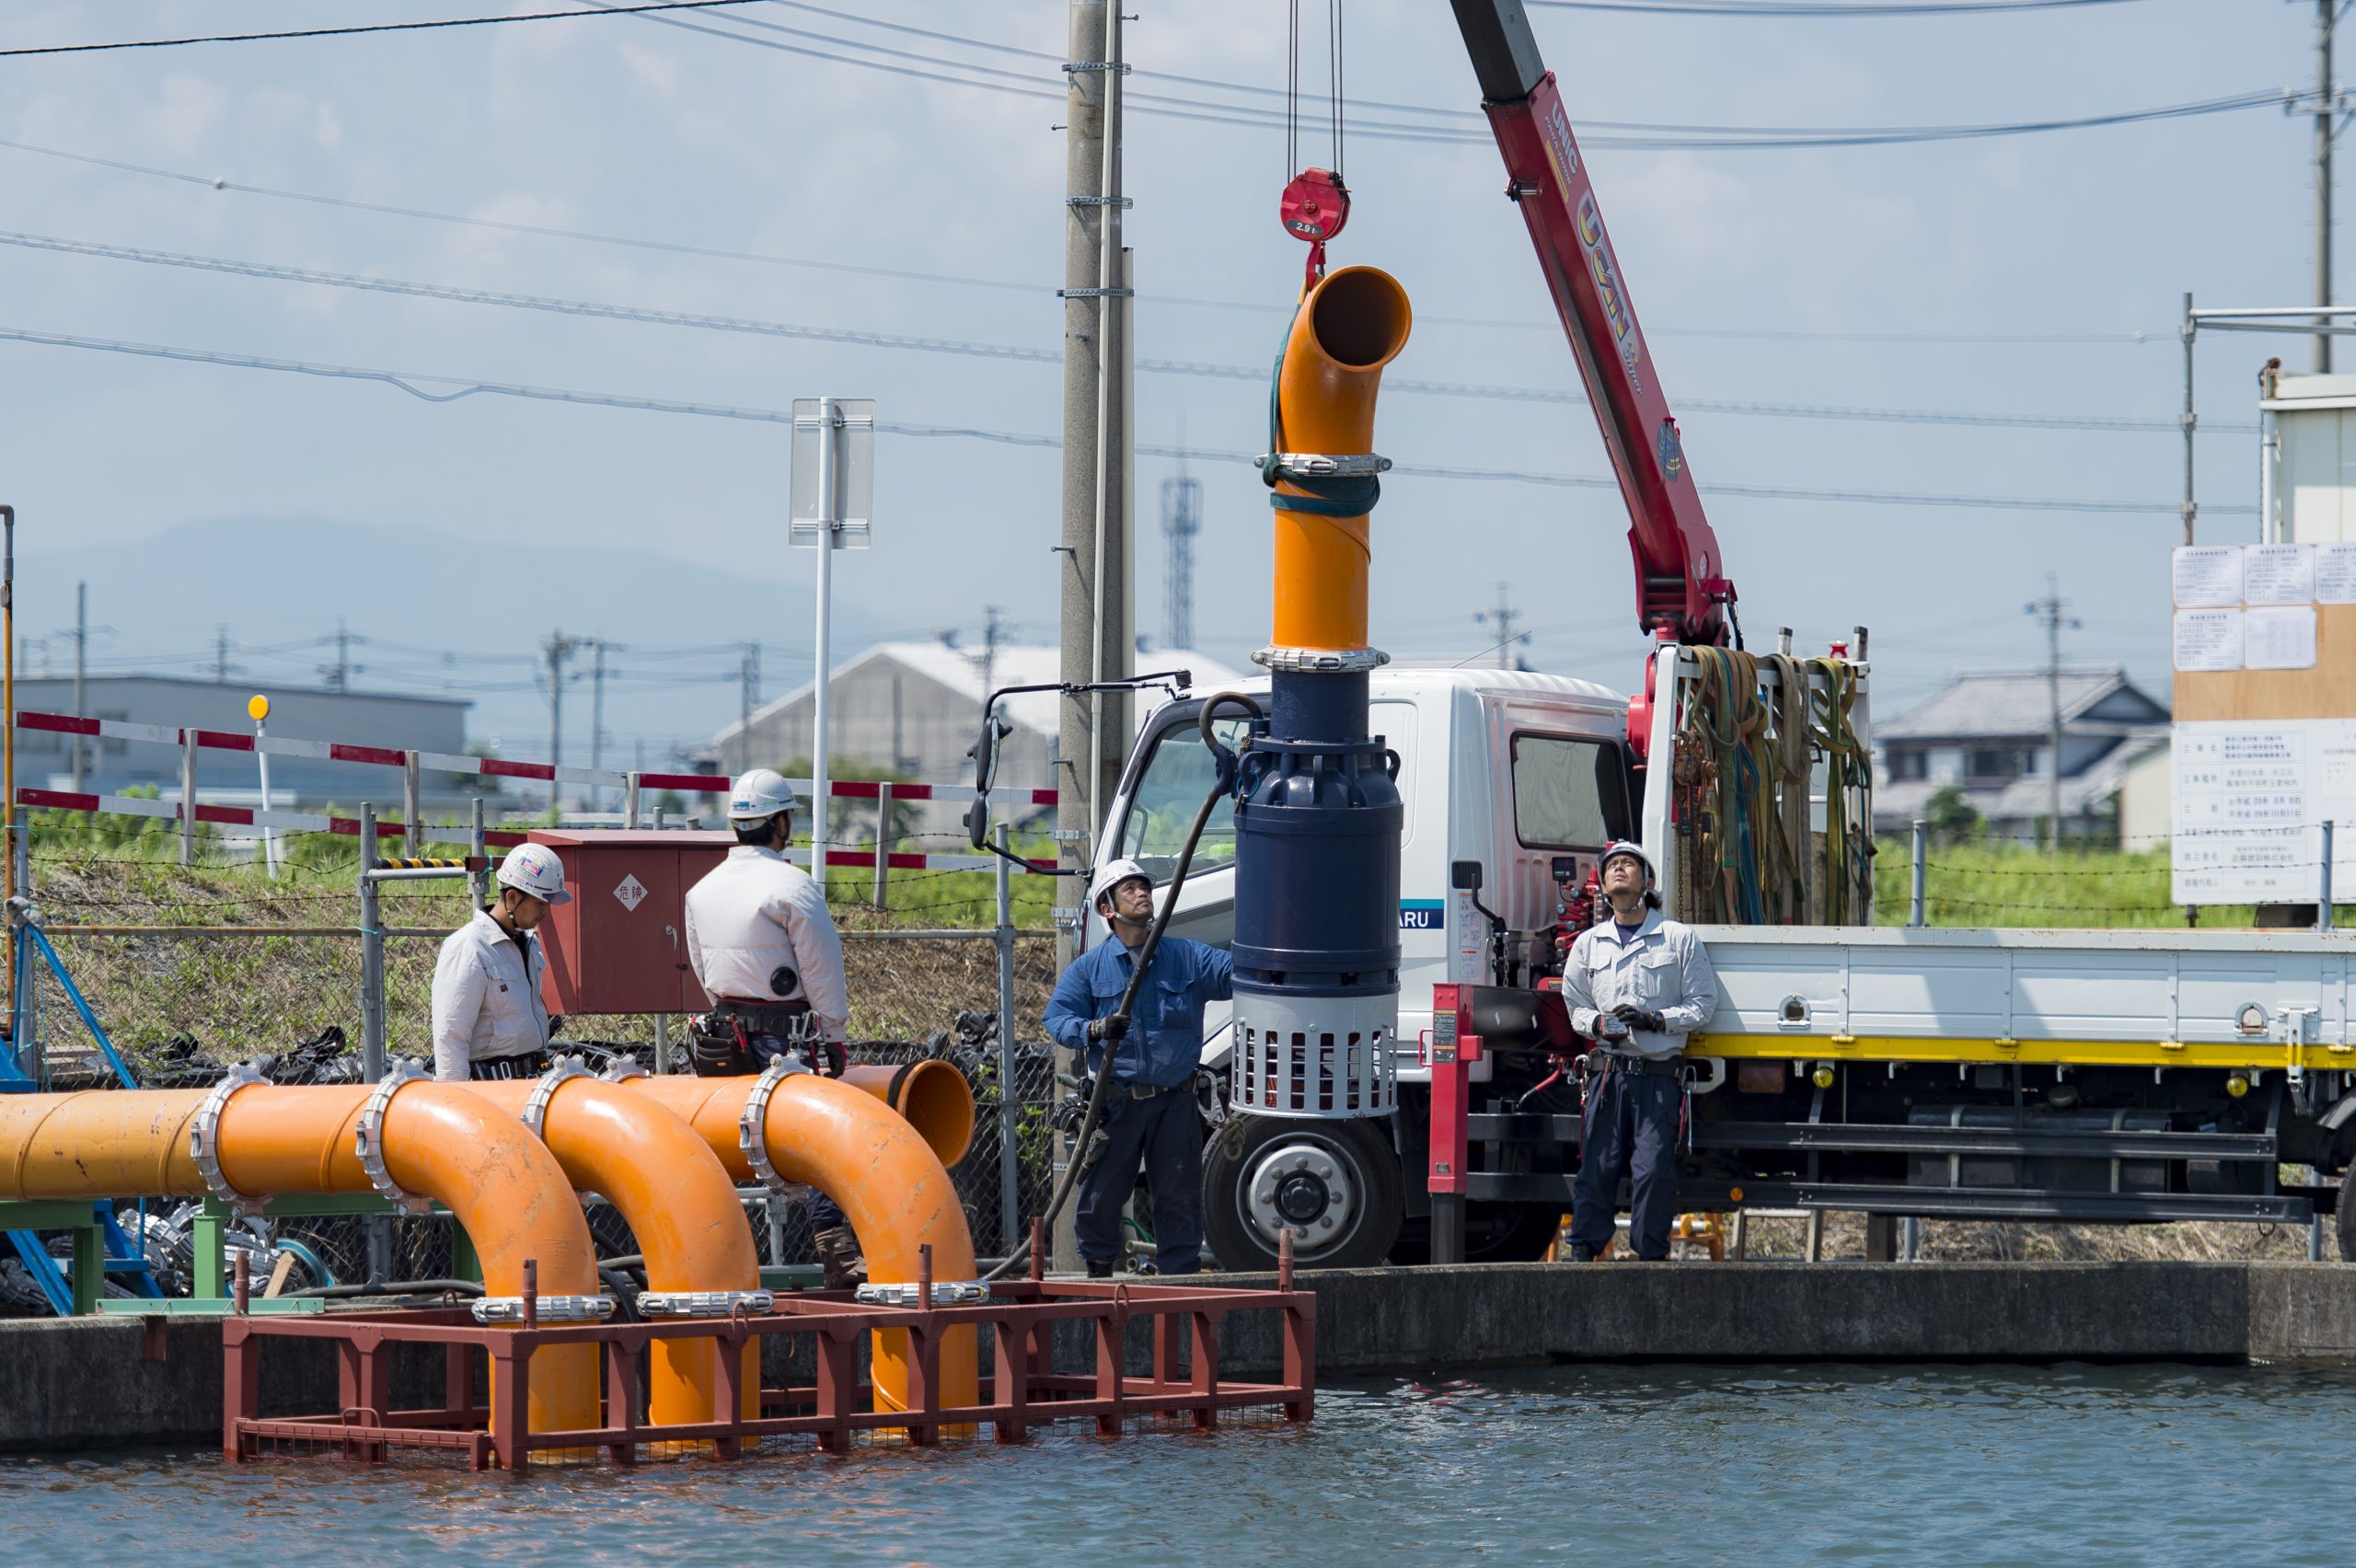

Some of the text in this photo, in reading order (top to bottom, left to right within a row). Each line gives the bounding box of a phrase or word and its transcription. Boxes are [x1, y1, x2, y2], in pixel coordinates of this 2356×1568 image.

[1552, 99, 1578, 176] UNIC
[1296, 222, 1311, 233] 2.9
[1623, 349, 1643, 396] Super
[618, 885, 642, 900] 危険
